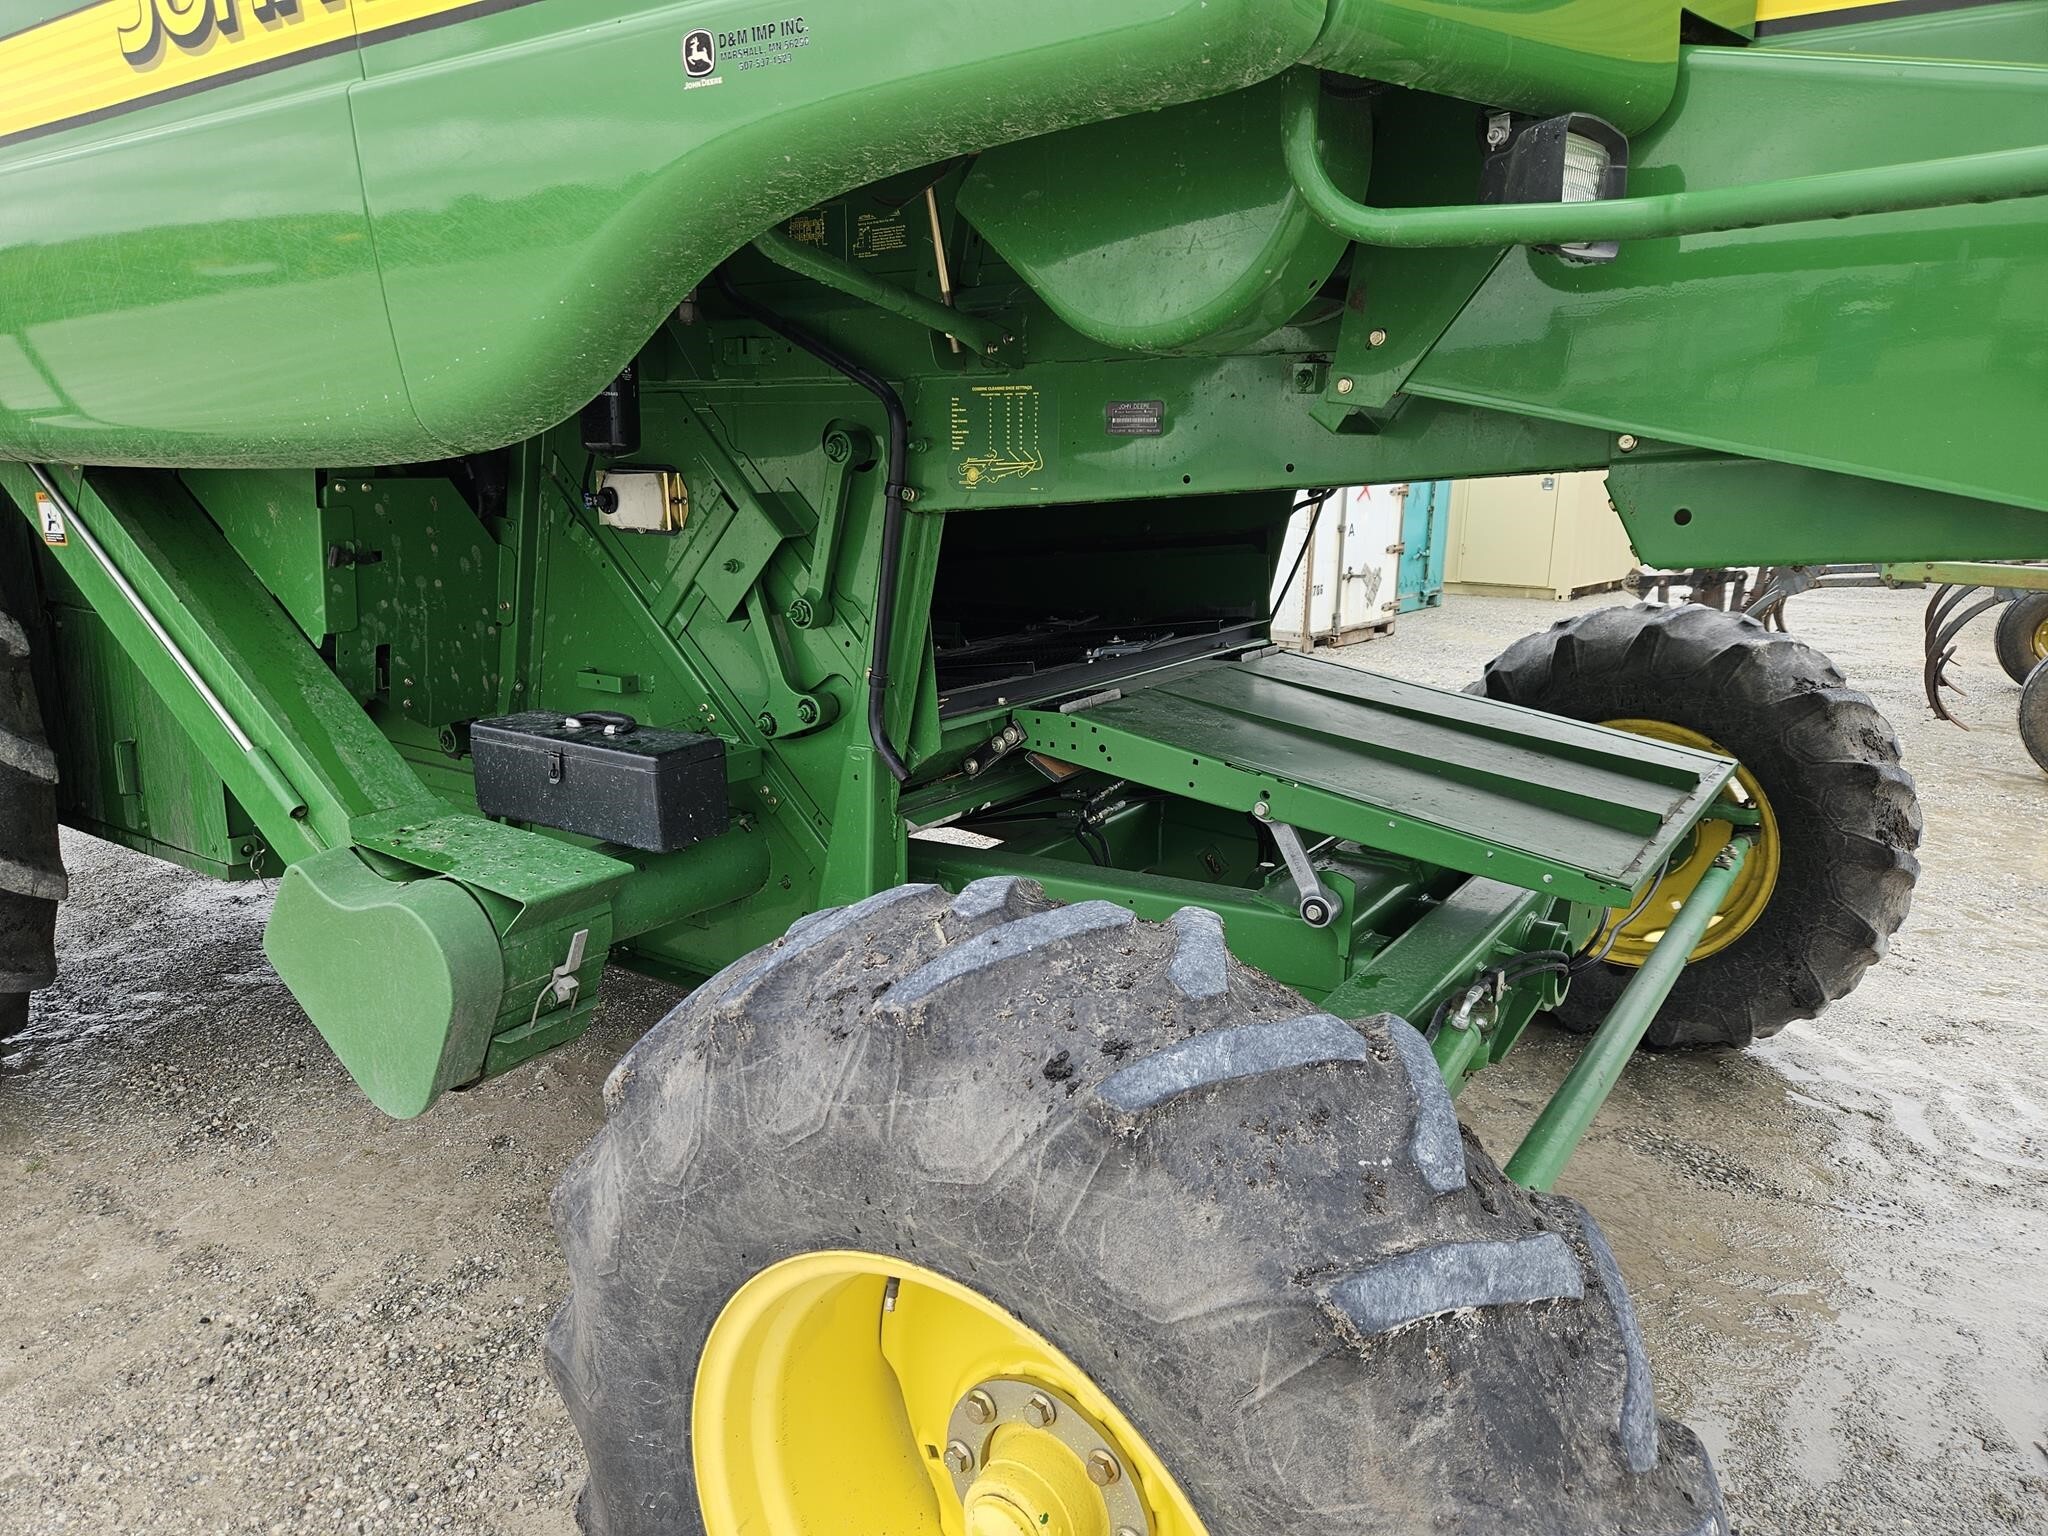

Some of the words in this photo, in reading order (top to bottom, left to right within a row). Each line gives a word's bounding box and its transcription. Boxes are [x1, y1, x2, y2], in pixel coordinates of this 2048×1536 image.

[718, 29, 748, 49] D&M
[751, 22, 776, 43] IMP
[780, 16, 809, 37] INC.
[768, 42, 782, 52] MN
[683, 81, 701, 91] JOHN
[701, 76, 723, 87] DEERE
[1348, 523, 1355, 537] A
